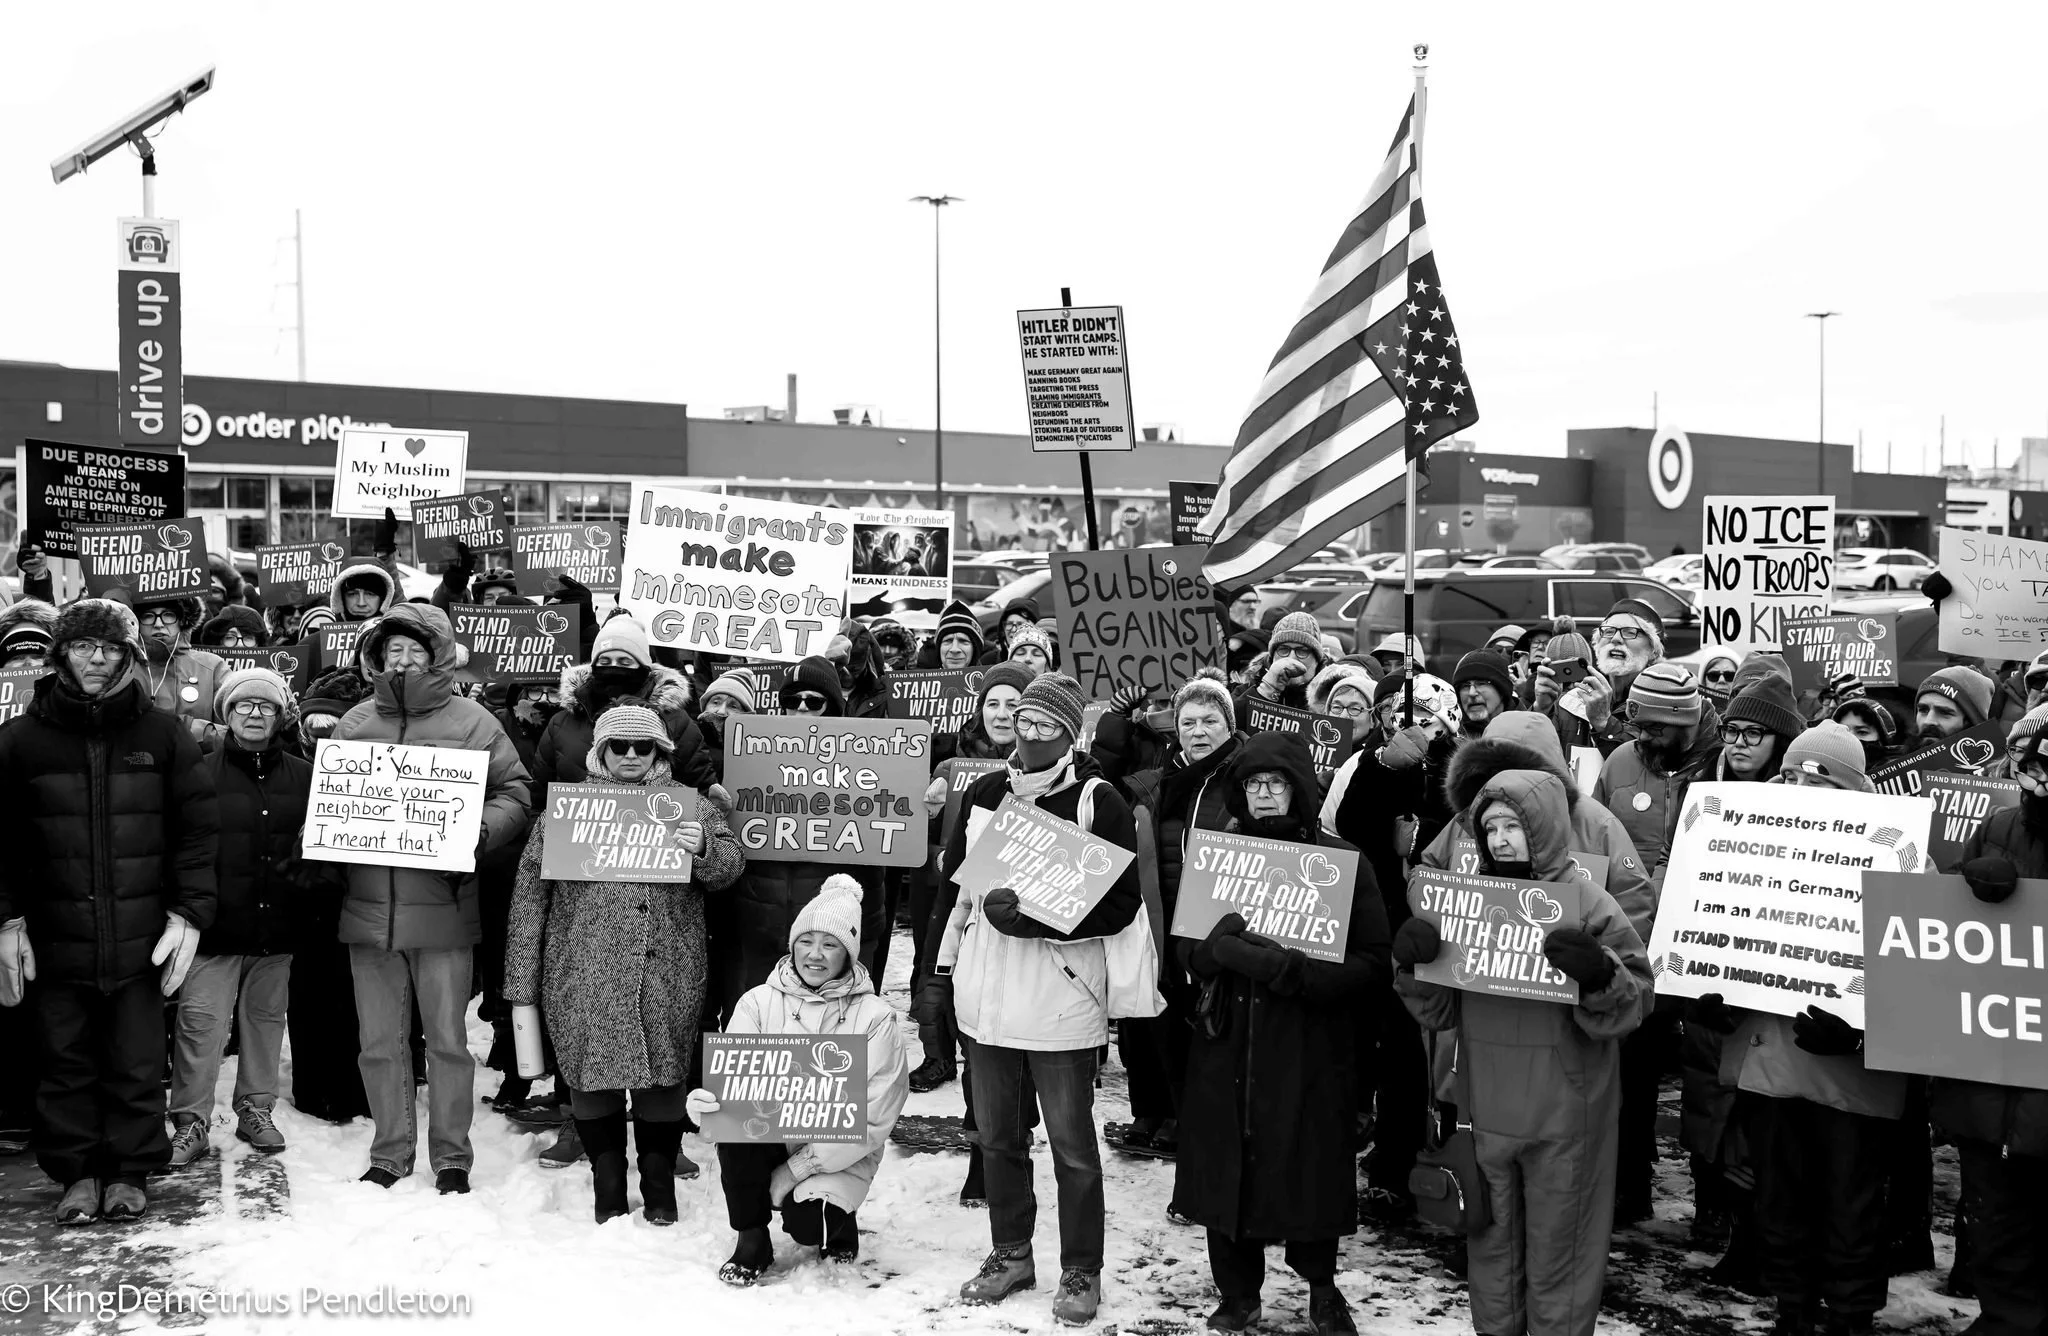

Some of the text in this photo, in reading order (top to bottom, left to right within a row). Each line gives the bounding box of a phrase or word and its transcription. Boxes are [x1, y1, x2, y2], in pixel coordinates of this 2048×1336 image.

[1022, 317, 1116, 334] HITLER DIDN'T
[1023, 333, 1119, 346] START WITH CAMPS.
[1025, 346, 1118, 358] HE STARTED WITH:
[130, 280, 169, 434] drive up
[216, 412, 296, 438] order
[43, 448, 169, 472] DUE PROCESS
[78, 466, 126, 479] MEANS
[352, 461, 449, 476] My Muslim
[45, 485, 167, 507] AMERICAN SOIL
[65, 475, 140, 492] NO ONE ON
[358, 483, 440, 499] Neighbor
[46, 497, 164, 517] CAN BE DEPRIVED OF
[58, 508, 90, 522] LIFE,
[416, 505, 458, 524] DEFEND
[640, 491, 848, 545] Immigrants
[425, 515, 495, 539] IMMIGRANT
[1708, 505, 1828, 545] NO ICE
[82, 535, 142, 555] DEFEND
[517, 533, 572, 552] DEFEND
[94, 550, 191, 575] IMMIGRANT
[262, 551, 310, 569] DEFEND
[527, 550, 609, 569] IMMIGRANT
[681, 542, 795, 576] make
[139, 568, 201, 593] RIGHTS
[271, 564, 342, 583] IMMIGRANT
[891, 578, 947, 588] KINDNESS
[1061, 554, 1209, 608] Bubbies
[1704, 552, 1834, 593] NO TROOPS
[632, 568, 841, 617] minnesota
[1960, 601, 1984, 620] Do
[456, 616, 510, 635] STAND
[652, 610, 822, 656] GREAT
[1069, 607, 1216, 648] AGAINST
[1703, 606, 1741, 645] NO
[1787, 626, 1834, 645] STAND
[1996, 629, 2031, 638] ICE
[474, 636, 555, 654] WITH OUR
[1804, 642, 1876, 662] WITH OUR
[496, 655, 573, 672] FAMILIES
[1072, 646, 1218, 697] FASCISM
[1824, 660, 1892, 678] FAMILIES
[892, 681, 941, 698] STAND
[910, 698, 947, 716] WITH
[733, 723, 928, 762] Immigrants
[320, 744, 472, 780] God: know
[781, 762, 880, 790] make
[320, 776, 444, 804] that love your
[737, 786, 913, 817] minnesota
[315, 797, 464, 834] neighbor thing?
[553, 797, 616, 820] STAND
[1930, 789, 1990, 818] STAND
[572, 822, 666, 846] WITH OUR
[994, 809, 1058, 851] STAND
[1723, 810, 1866, 834] My ancestors fled
[314, 824, 386, 848] I meant
[741, 818, 907, 853] GREAT
[1196, 832, 1300, 853] STAND WITH IMMIGRANTS
[595, 846, 685, 869] FAMILIES
[1194, 846, 1265, 878] STAND
[1708, 839, 1873, 868] GENOCIDE in Ireland
[996, 840, 1085, 894] WITH OUR
[1419, 871, 1516, 890] STAND WITH IMMIGRANTS
[1699, 872, 1862, 903] and WAR in Germany
[1003, 872, 1086, 918] FAMILIES
[1212, 875, 1319, 914] WITH OUR
[1421, 885, 1483, 918] STAND
[1240, 906, 1340, 944] FAMILIES
[1694, 900, 1860, 934] I am an AMERICAN.
[1441, 916, 1544, 953] WITH OUR
[1879, 916, 2044, 968] ABOLI
[1674, 930, 1864, 970] I STAND WITH REFUGEE
[1686, 960, 1842, 999] AND IMMIGRANTS.
[1961, 992, 2042, 1042] ICE
[710, 1050, 792, 1075] DEFEND
[722, 1077, 848, 1101] IMMIGRANT
[779, 1103, 857, 1128] RIGHTS
